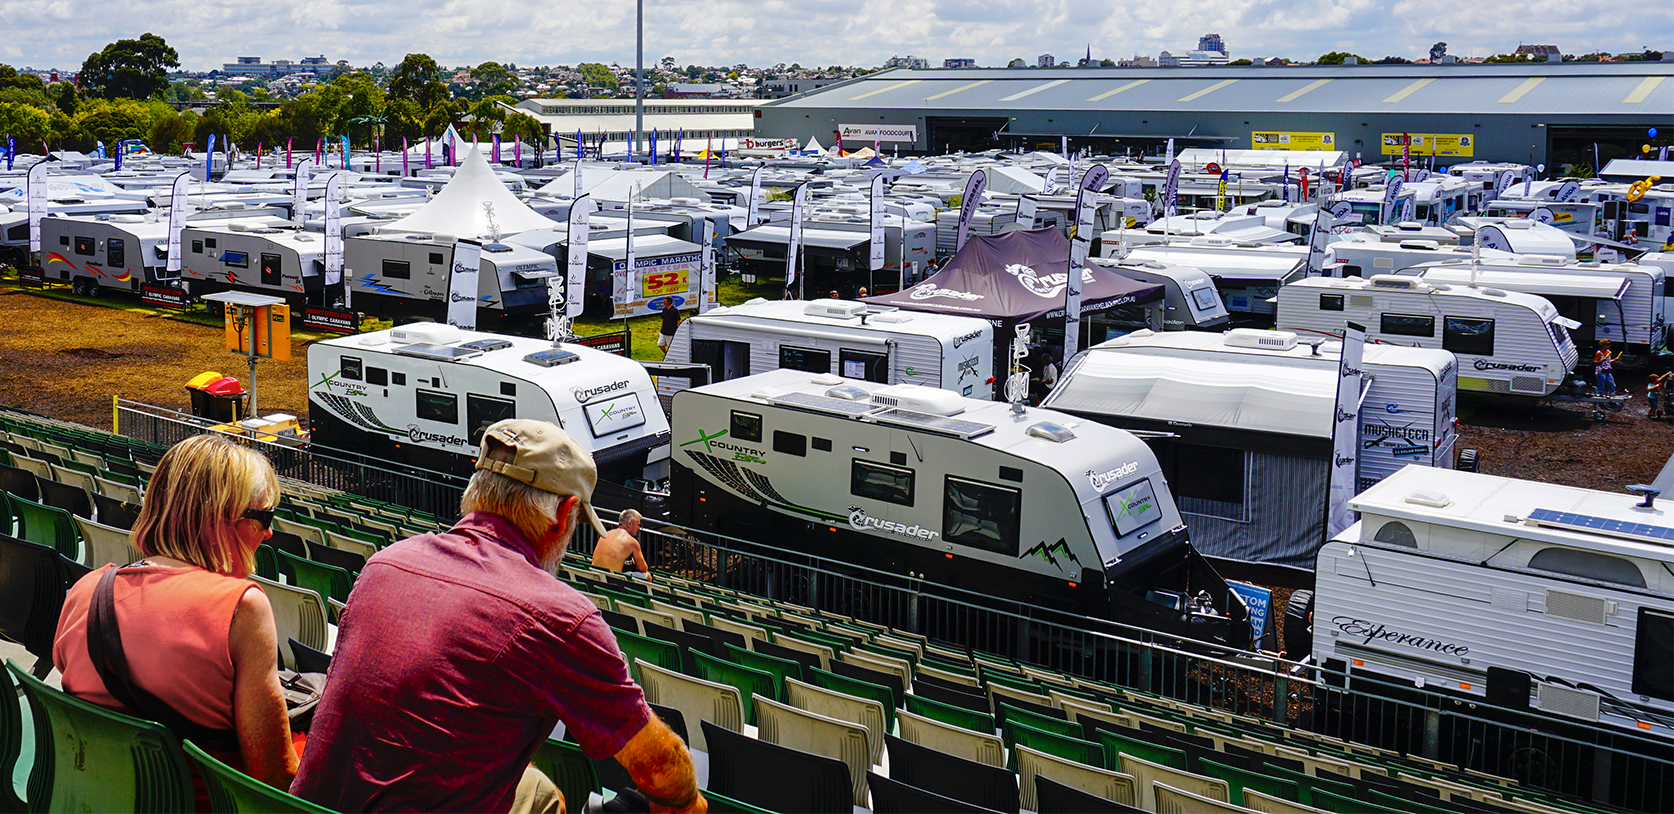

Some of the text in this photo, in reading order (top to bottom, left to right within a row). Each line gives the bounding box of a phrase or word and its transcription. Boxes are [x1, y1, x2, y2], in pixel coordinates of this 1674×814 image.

[755, 140, 784, 148] burgers
[1561, 186, 1577, 202] AVIDA
[620, 254, 701, 269] OMPIC MARATHO
[910, 283, 985, 301] Crusader
[953, 329, 983, 349] Crusader
[1474, 358, 1541, 372] Crusader
[328, 379, 368, 391] COUNTRY
[574, 380, 630, 403] Crusader
[609, 406, 636, 416] COUNTRY
[409, 424, 468, 446] Crusader
[710, 440, 766, 457] COUNTRY
[1088, 461, 1138, 493] Crusader
[1127, 496, 1151, 510] COUNTRY
[848, 506, 940, 540] Crusader
[1332, 616, 1470, 657] Esperance
